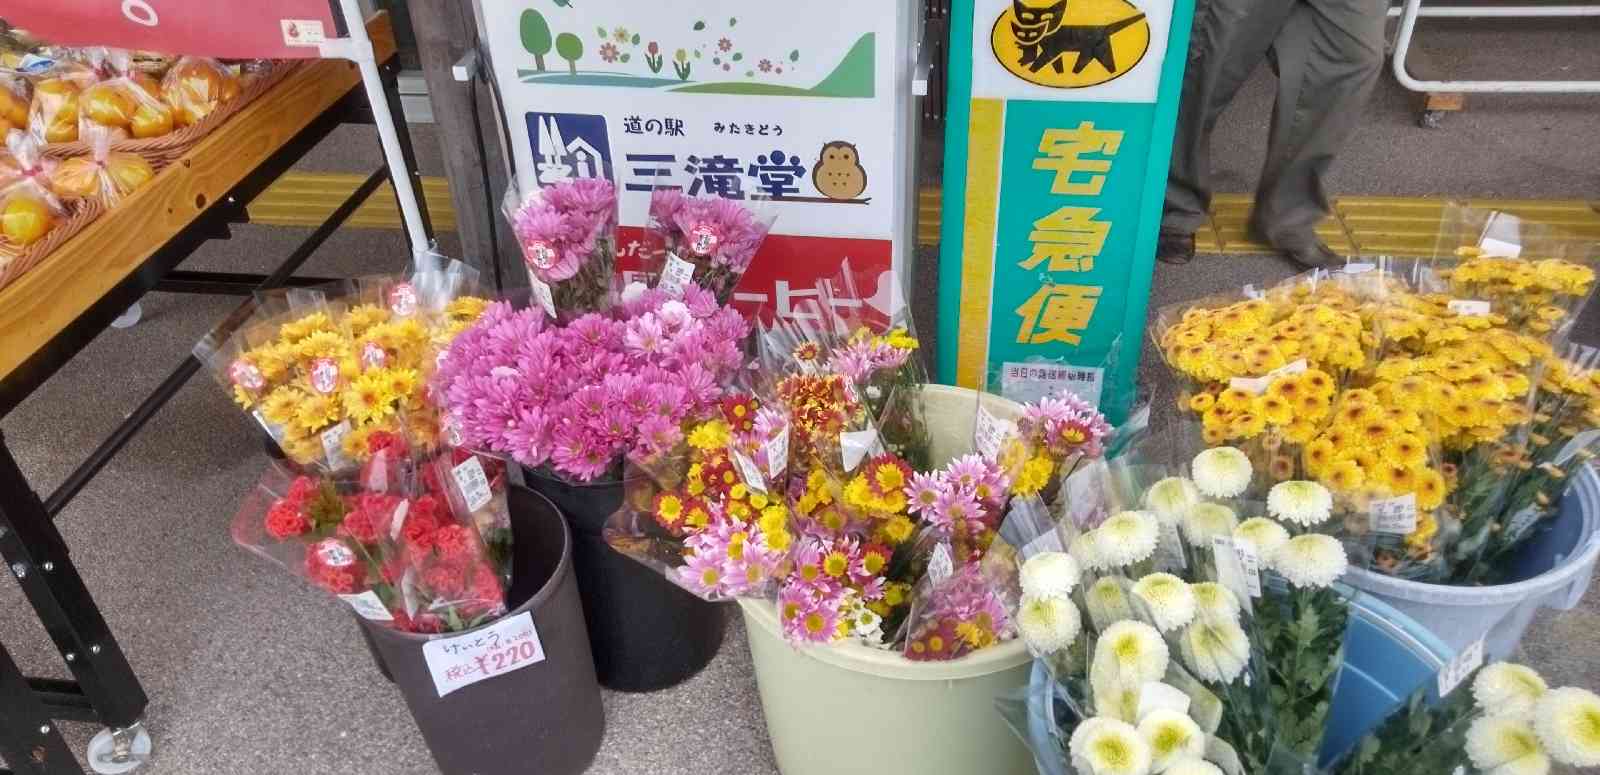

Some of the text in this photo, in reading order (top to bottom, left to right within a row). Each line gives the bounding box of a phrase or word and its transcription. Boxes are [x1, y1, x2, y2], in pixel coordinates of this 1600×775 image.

[623, 116, 685, 137] 道の駅
[713, 122, 784, 136] みたきどう
[625, 149, 808, 200] 三滝堂
[1014, 120, 1125, 347] 宅急便
